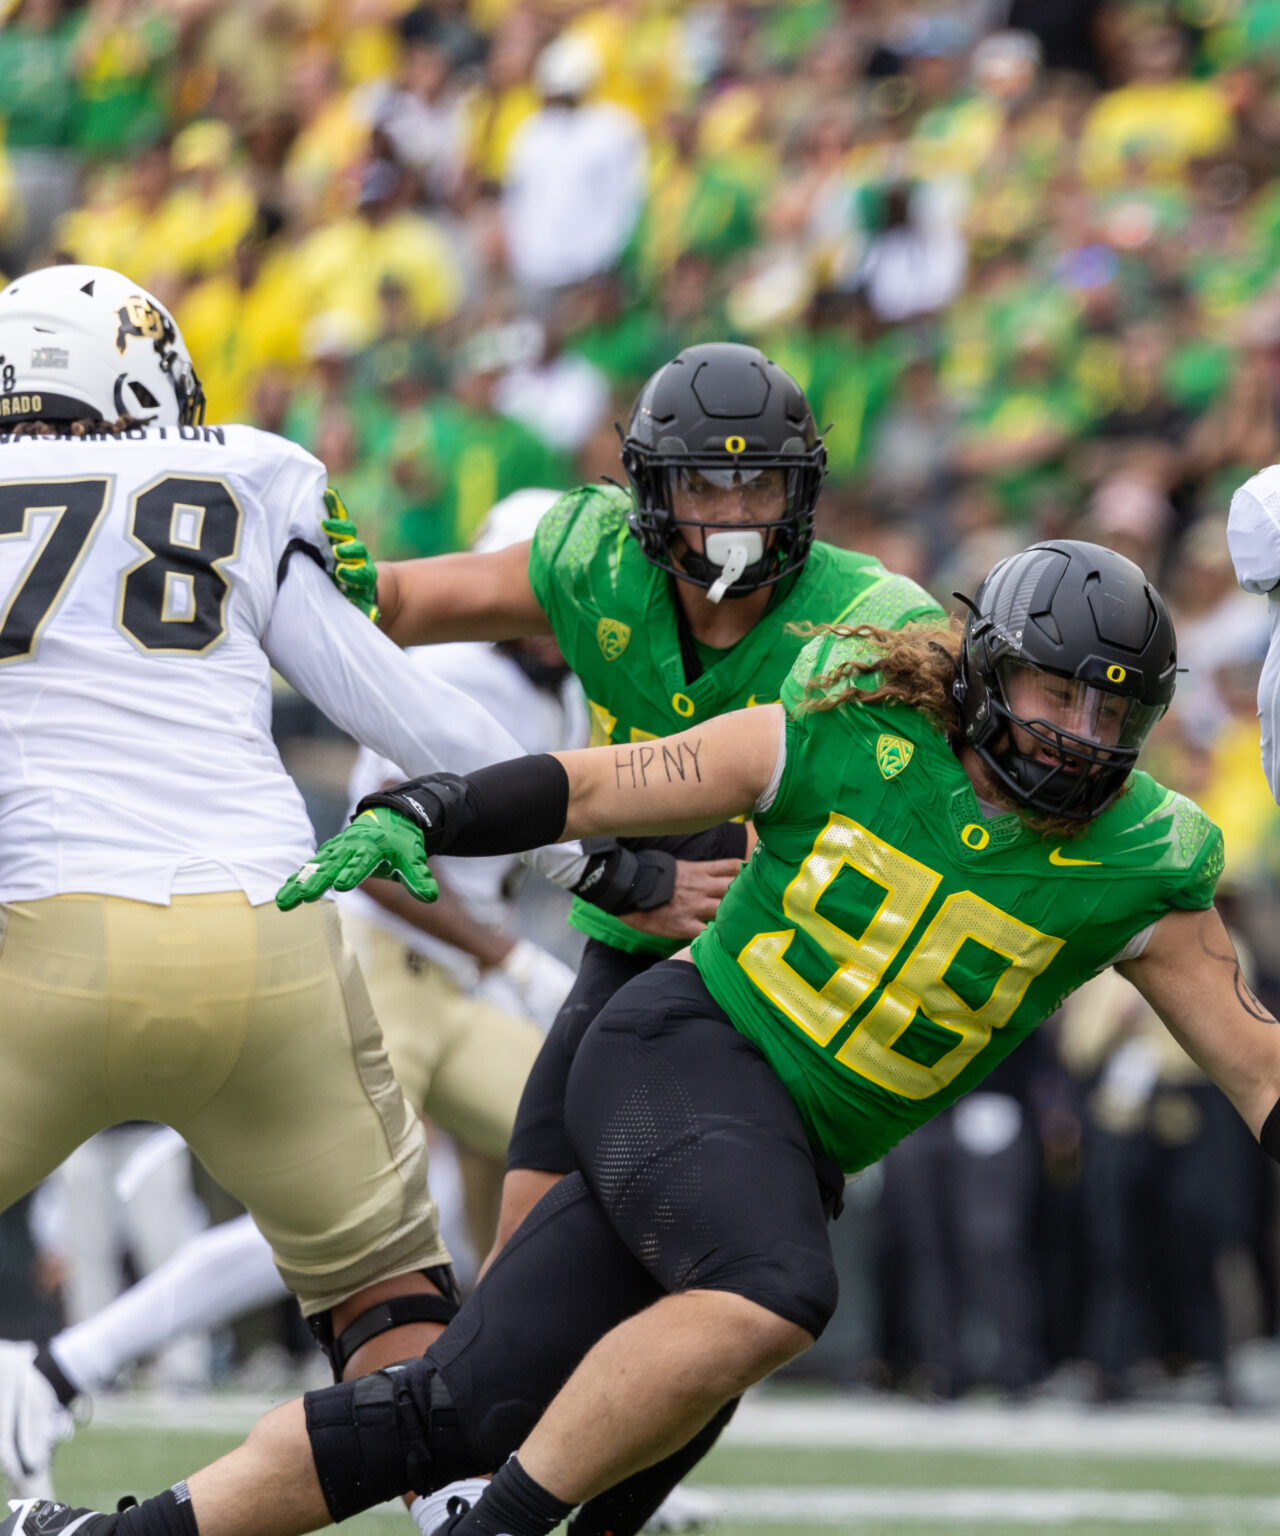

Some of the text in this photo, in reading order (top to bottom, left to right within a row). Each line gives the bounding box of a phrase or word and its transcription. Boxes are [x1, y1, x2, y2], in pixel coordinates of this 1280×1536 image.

[0, 394, 42, 417] RADO
[0, 469, 245, 668] 78
[882, 754, 900, 772] 12
[737, 811, 1067, 1100] 98
